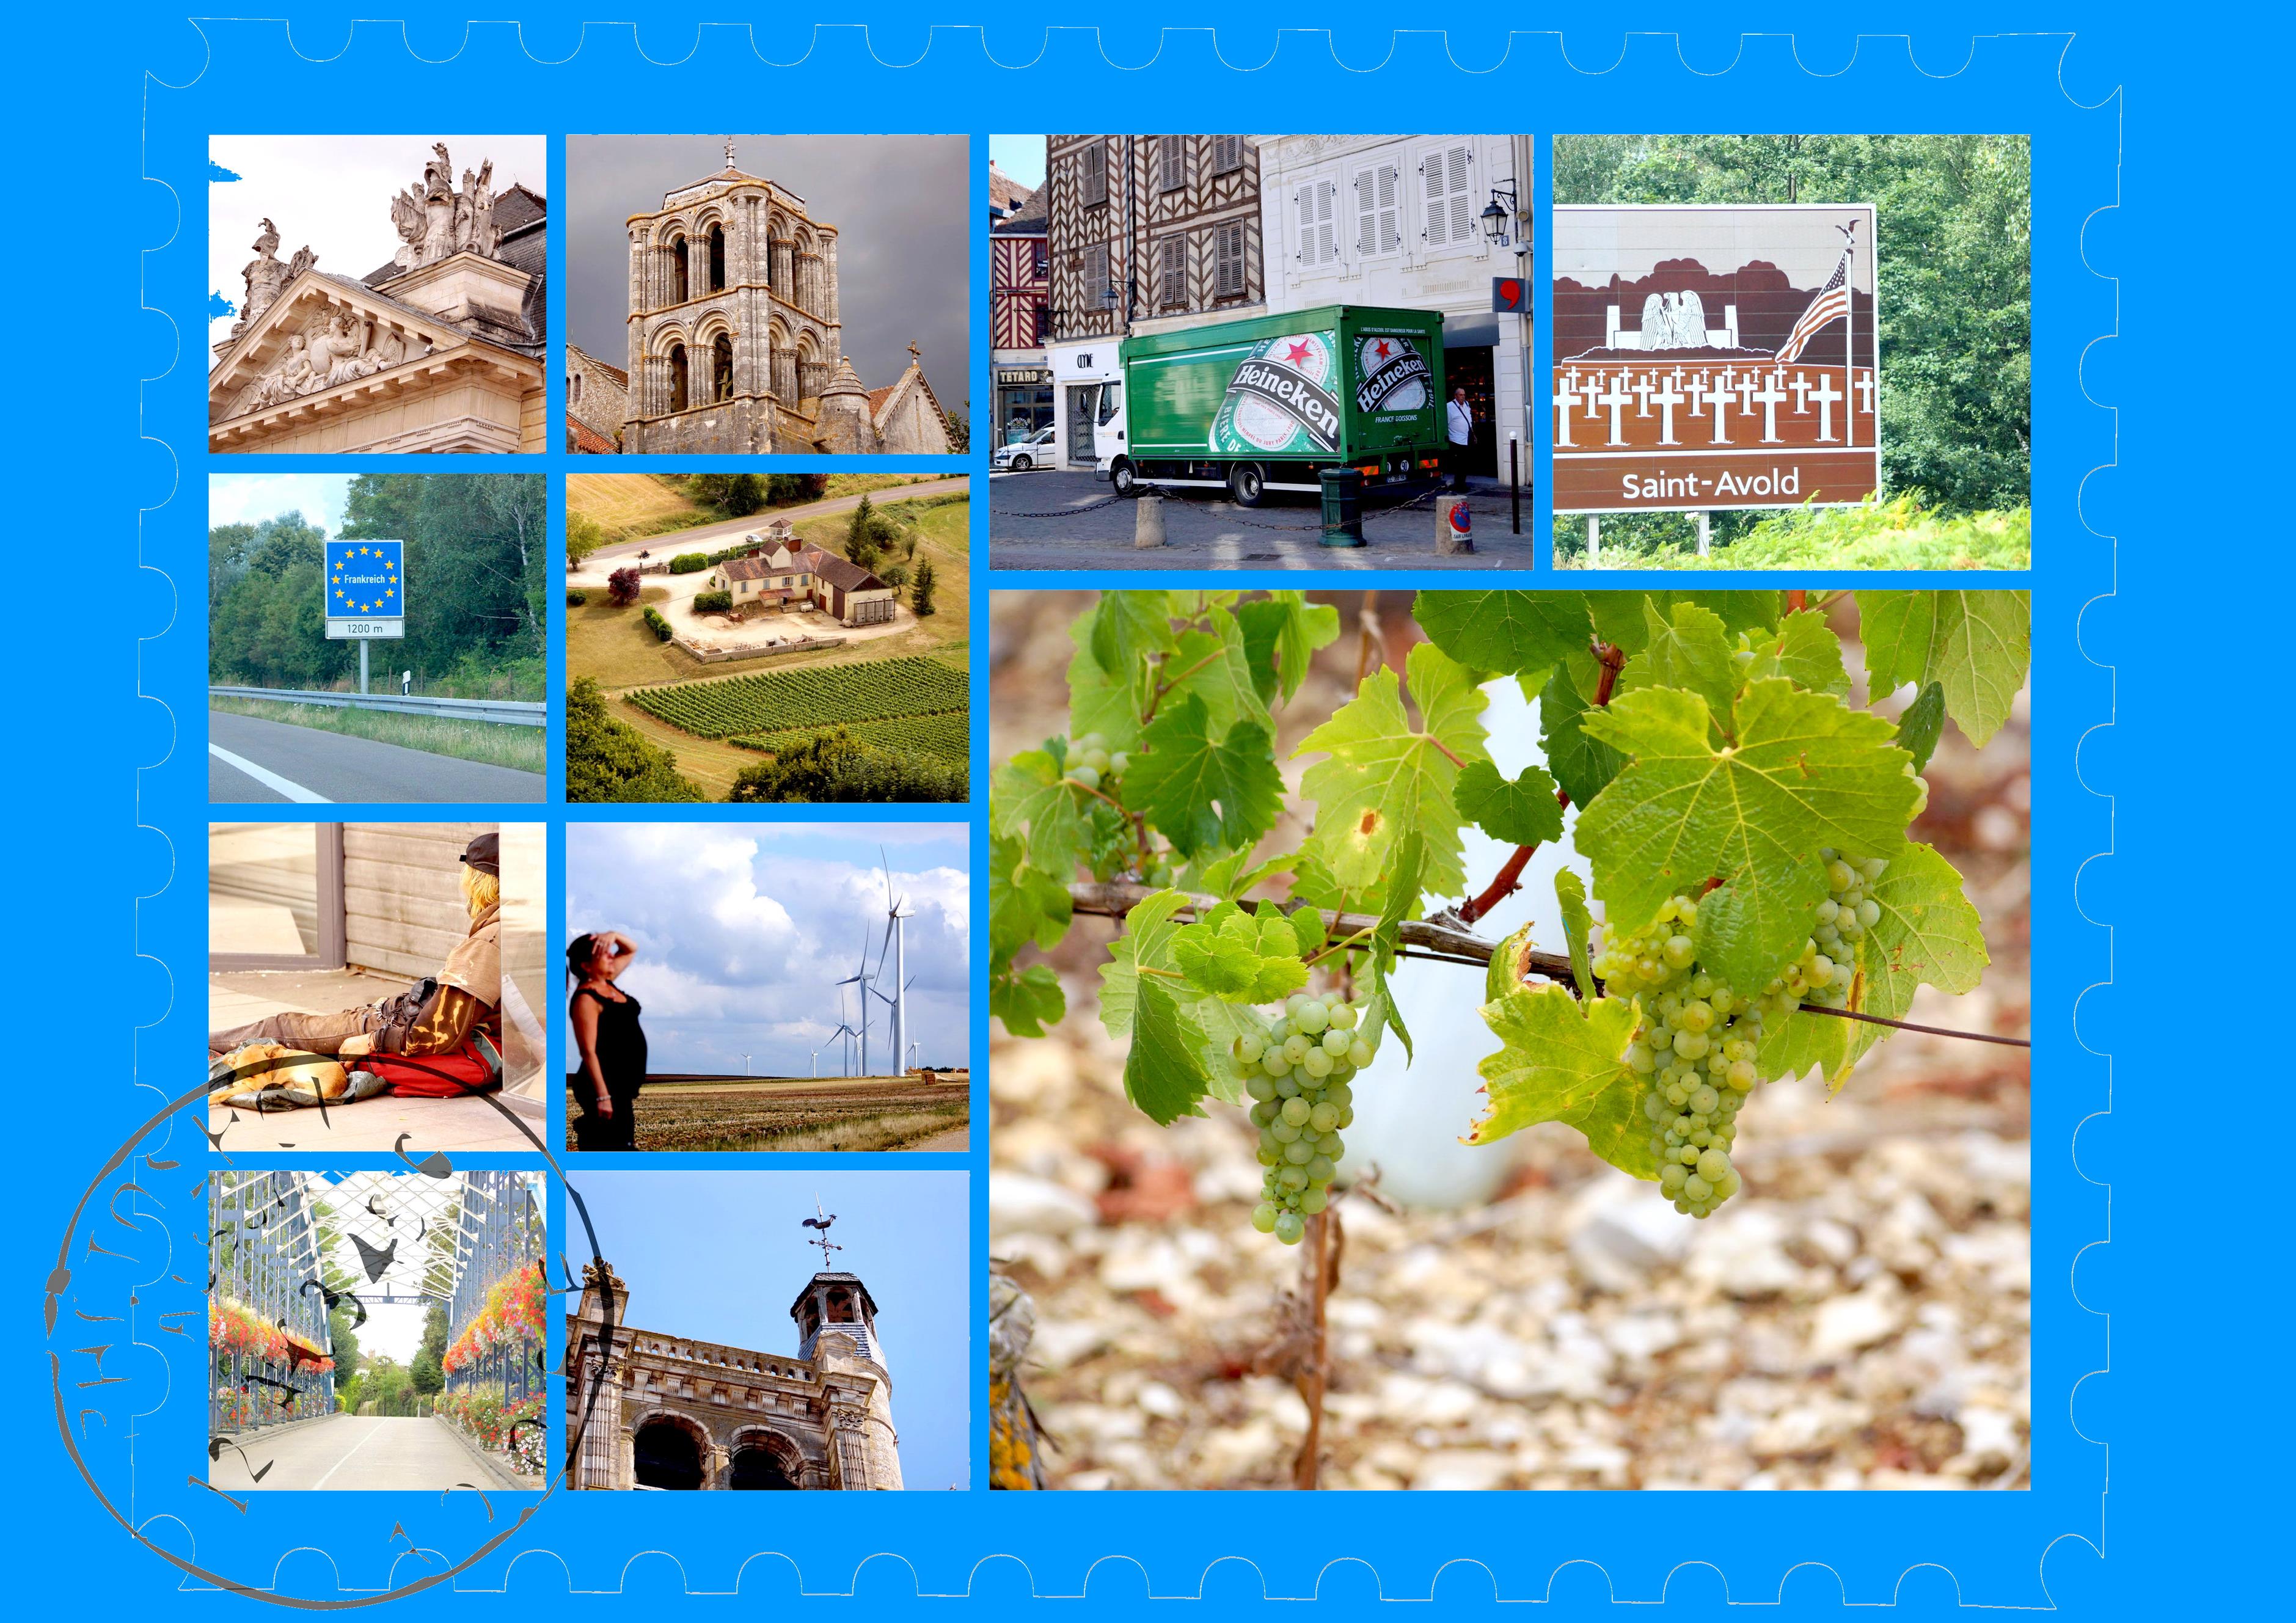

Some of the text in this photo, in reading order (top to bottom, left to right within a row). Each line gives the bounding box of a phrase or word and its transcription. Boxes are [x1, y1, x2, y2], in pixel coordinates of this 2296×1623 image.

[1503, 236, 1508, 246] 8
[1309, 338, 1323, 365] AMSTERDAM
[1000, 371, 1037, 382] TETARD
[1358, 356, 1426, 412] Heineken
[1233, 365, 1339, 439] Heineken
[1219, 406, 1233, 443] BIERE
[1241, 428, 1256, 440] MEMBRE
[1276, 432, 1287, 444] PARIS
[1286, 420, 1295, 432] 1900
[1623, 467, 1799, 499] Saint-Avold
[344, 574, 385, 584] Frankreich
[348, 624, 370, 633] 1200
